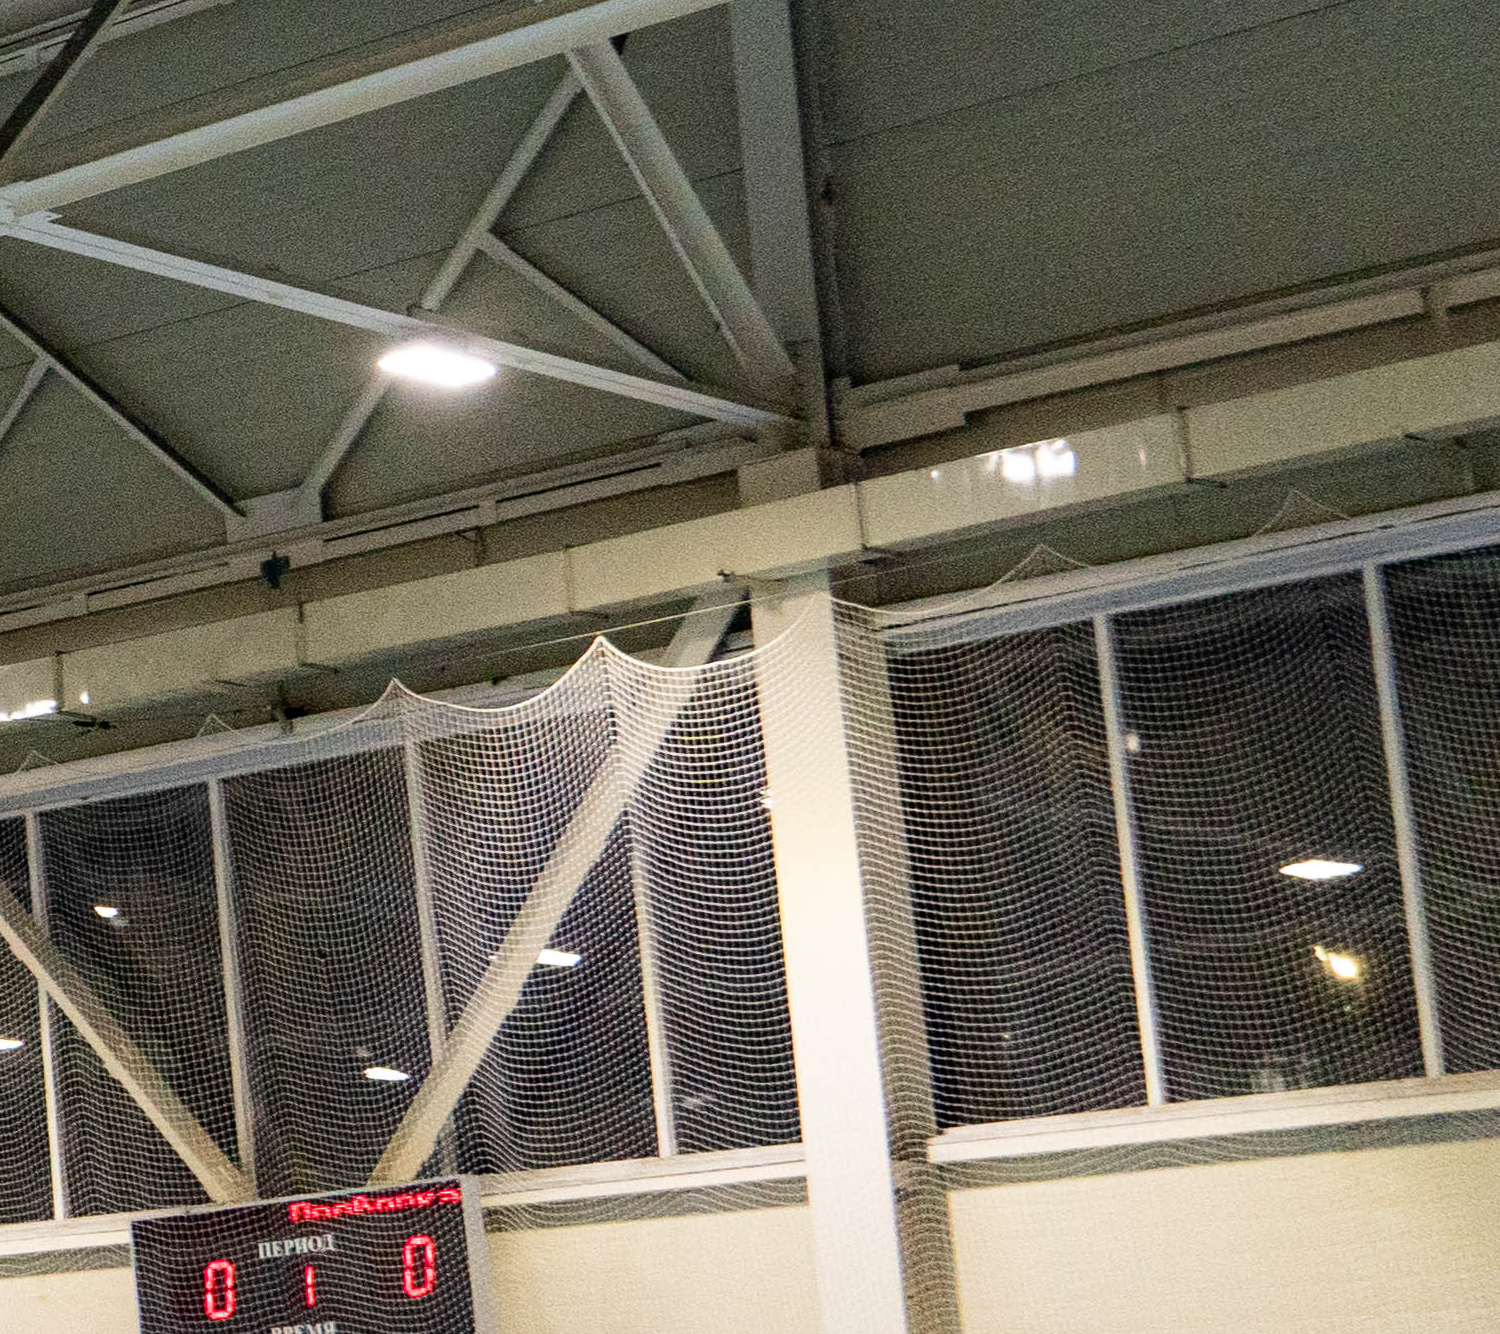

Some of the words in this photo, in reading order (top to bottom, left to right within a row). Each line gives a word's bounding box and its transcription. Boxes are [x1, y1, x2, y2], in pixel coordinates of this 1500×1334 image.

[258, 1233, 335, 1259] ПЕРИОД
[402, 1234, 436, 1299] 0
[203, 1259, 236, 1321] 0
[304, 1265, 316, 1307] 1
